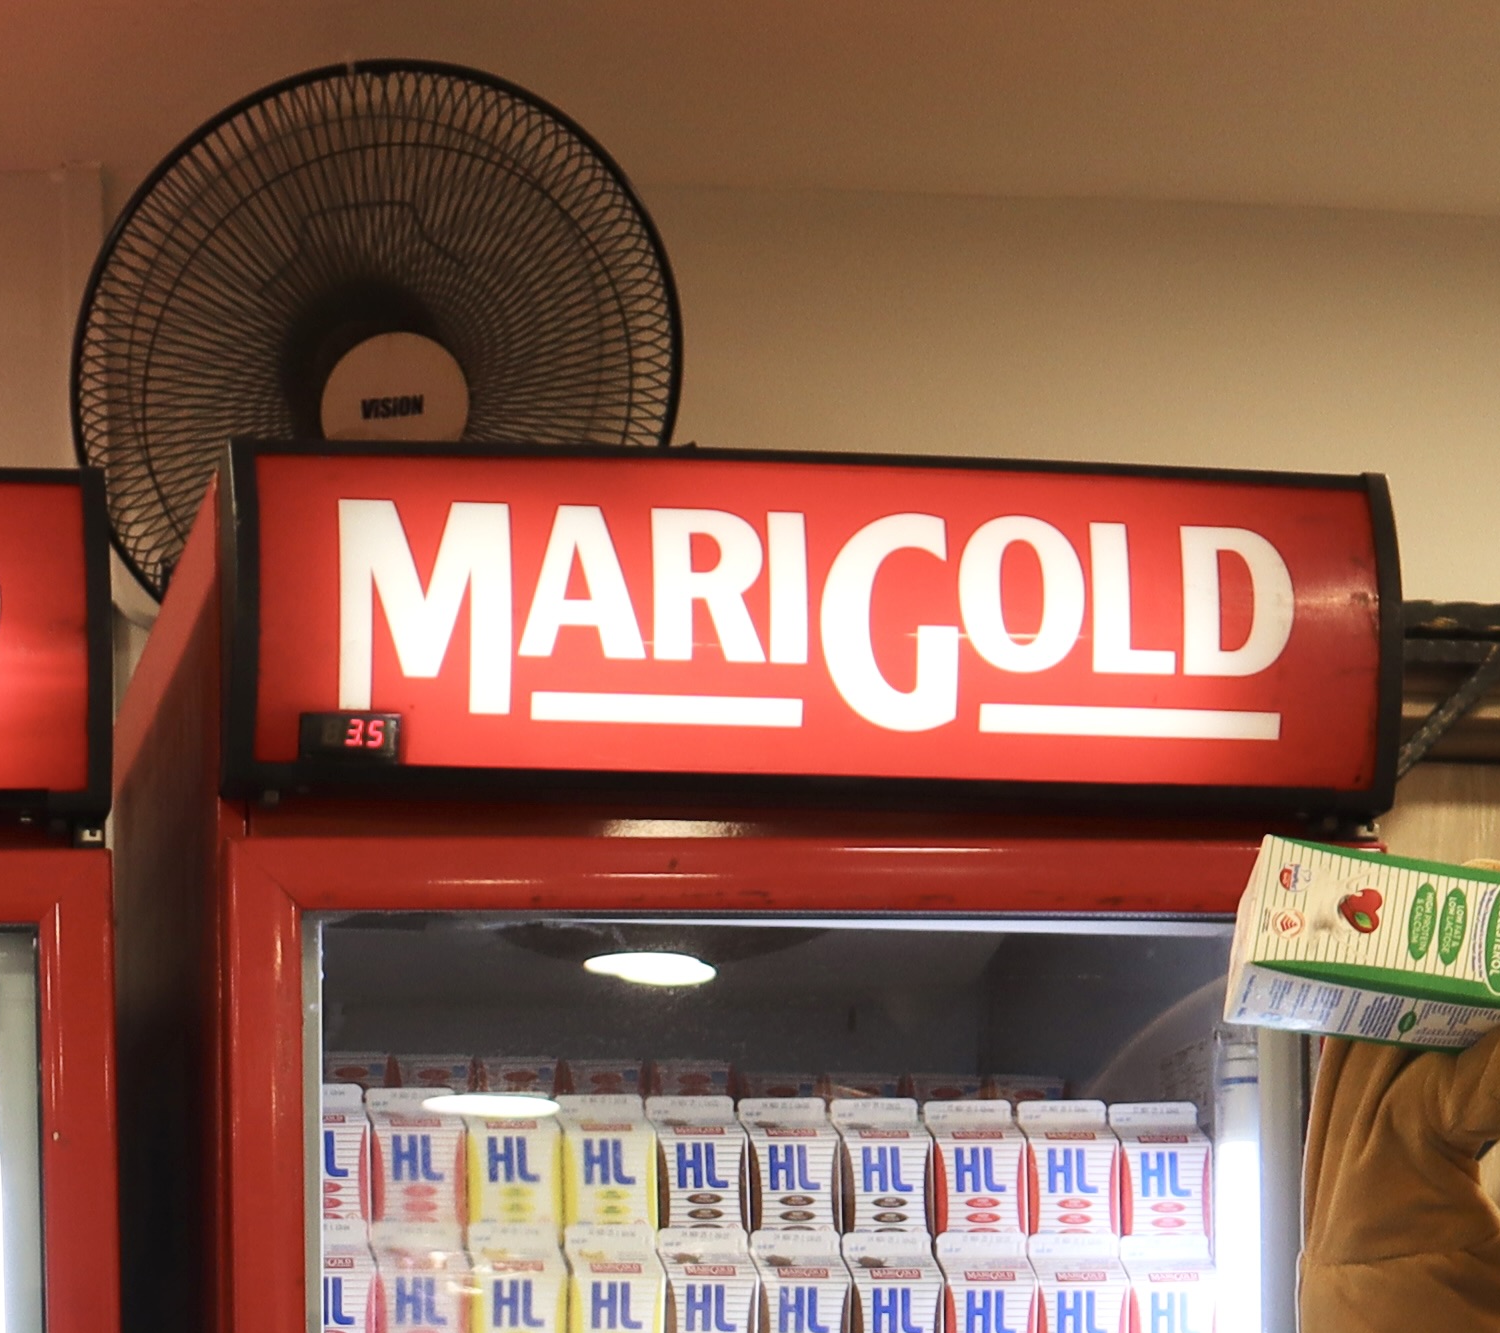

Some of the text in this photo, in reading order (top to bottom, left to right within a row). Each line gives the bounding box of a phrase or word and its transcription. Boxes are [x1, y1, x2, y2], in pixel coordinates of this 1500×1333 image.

[338, 497, 1296, 731] MARIGOLD
[675, 1143, 729, 1189] HL
[767, 1144, 820, 1192] HL
[861, 1146, 915, 1194] HL
[953, 1146, 1008, 1194] HL
[1046, 1147, 1099, 1195] HL
[1138, 1150, 1193, 1199] HL
[685, 1284, 737, 1333] HL
